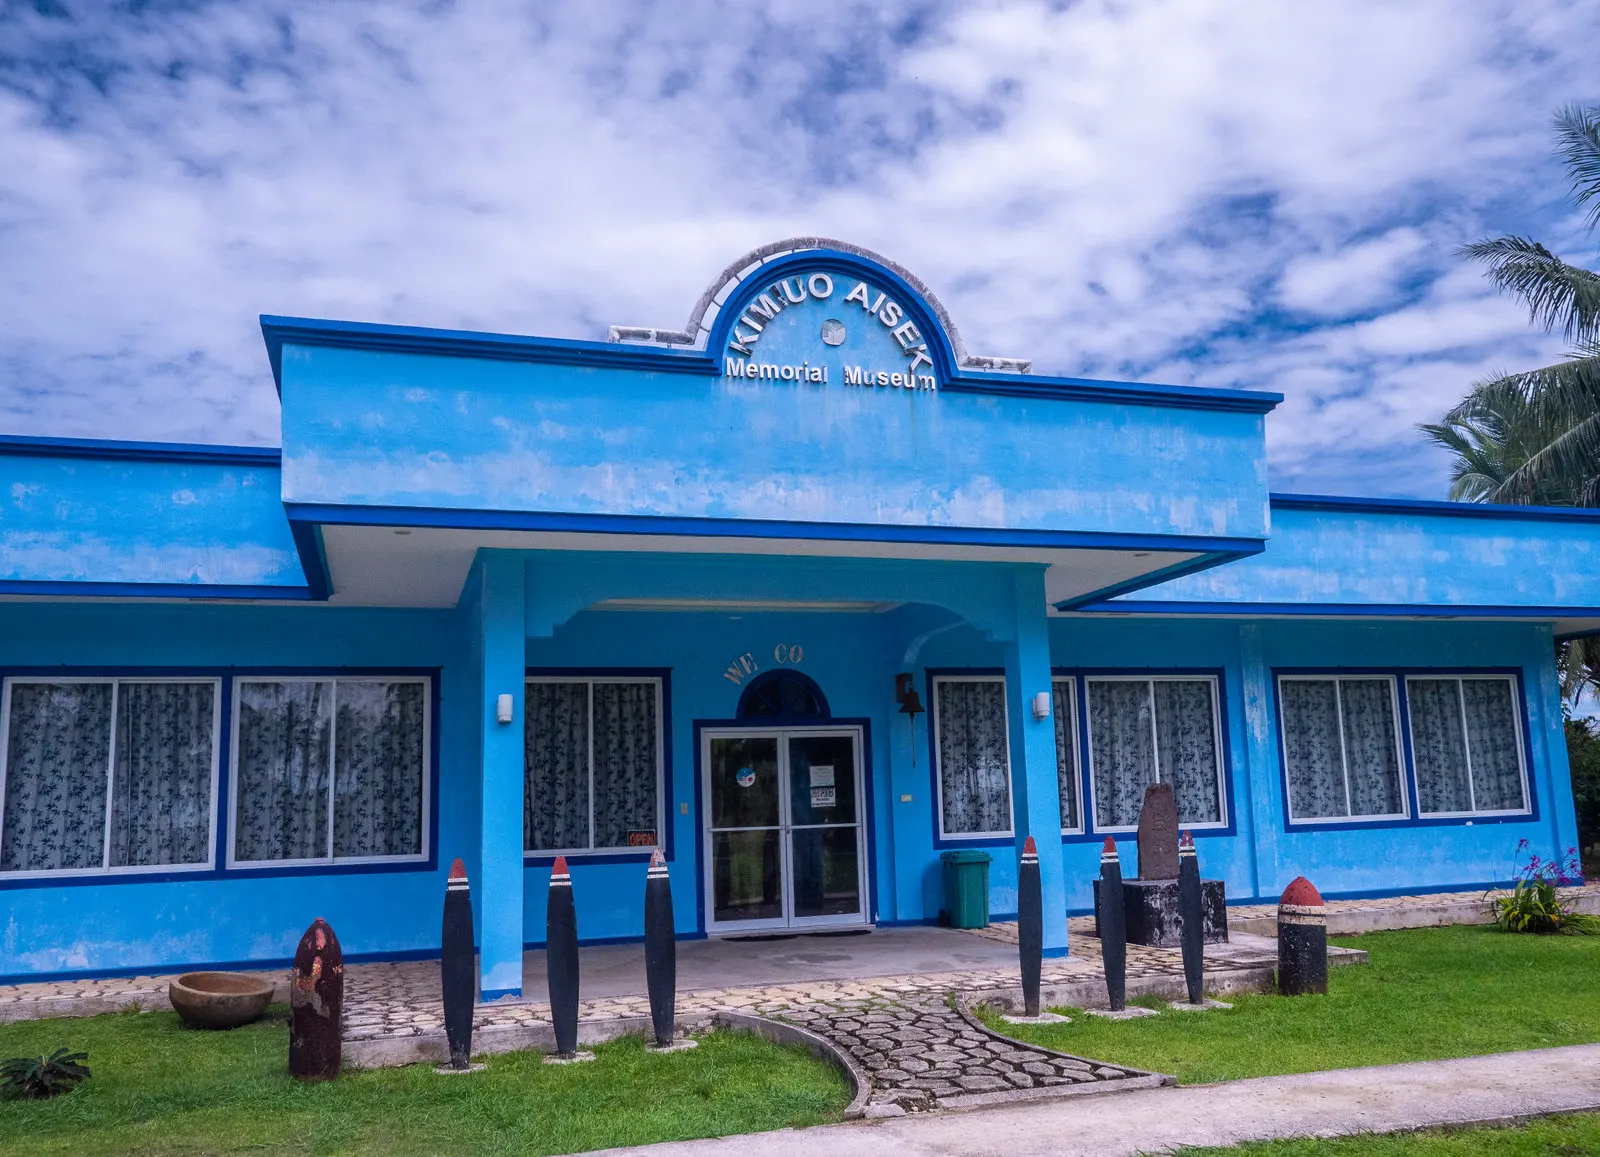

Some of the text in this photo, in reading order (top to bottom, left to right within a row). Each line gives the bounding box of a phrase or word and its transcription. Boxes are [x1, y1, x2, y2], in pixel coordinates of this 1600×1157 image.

[845, 282, 933, 372] AISEK
[725, 356, 936, 390] Memorial Museum
[723, 643, 804, 685] WE CO
[629, 833, 654, 846] OPEN
